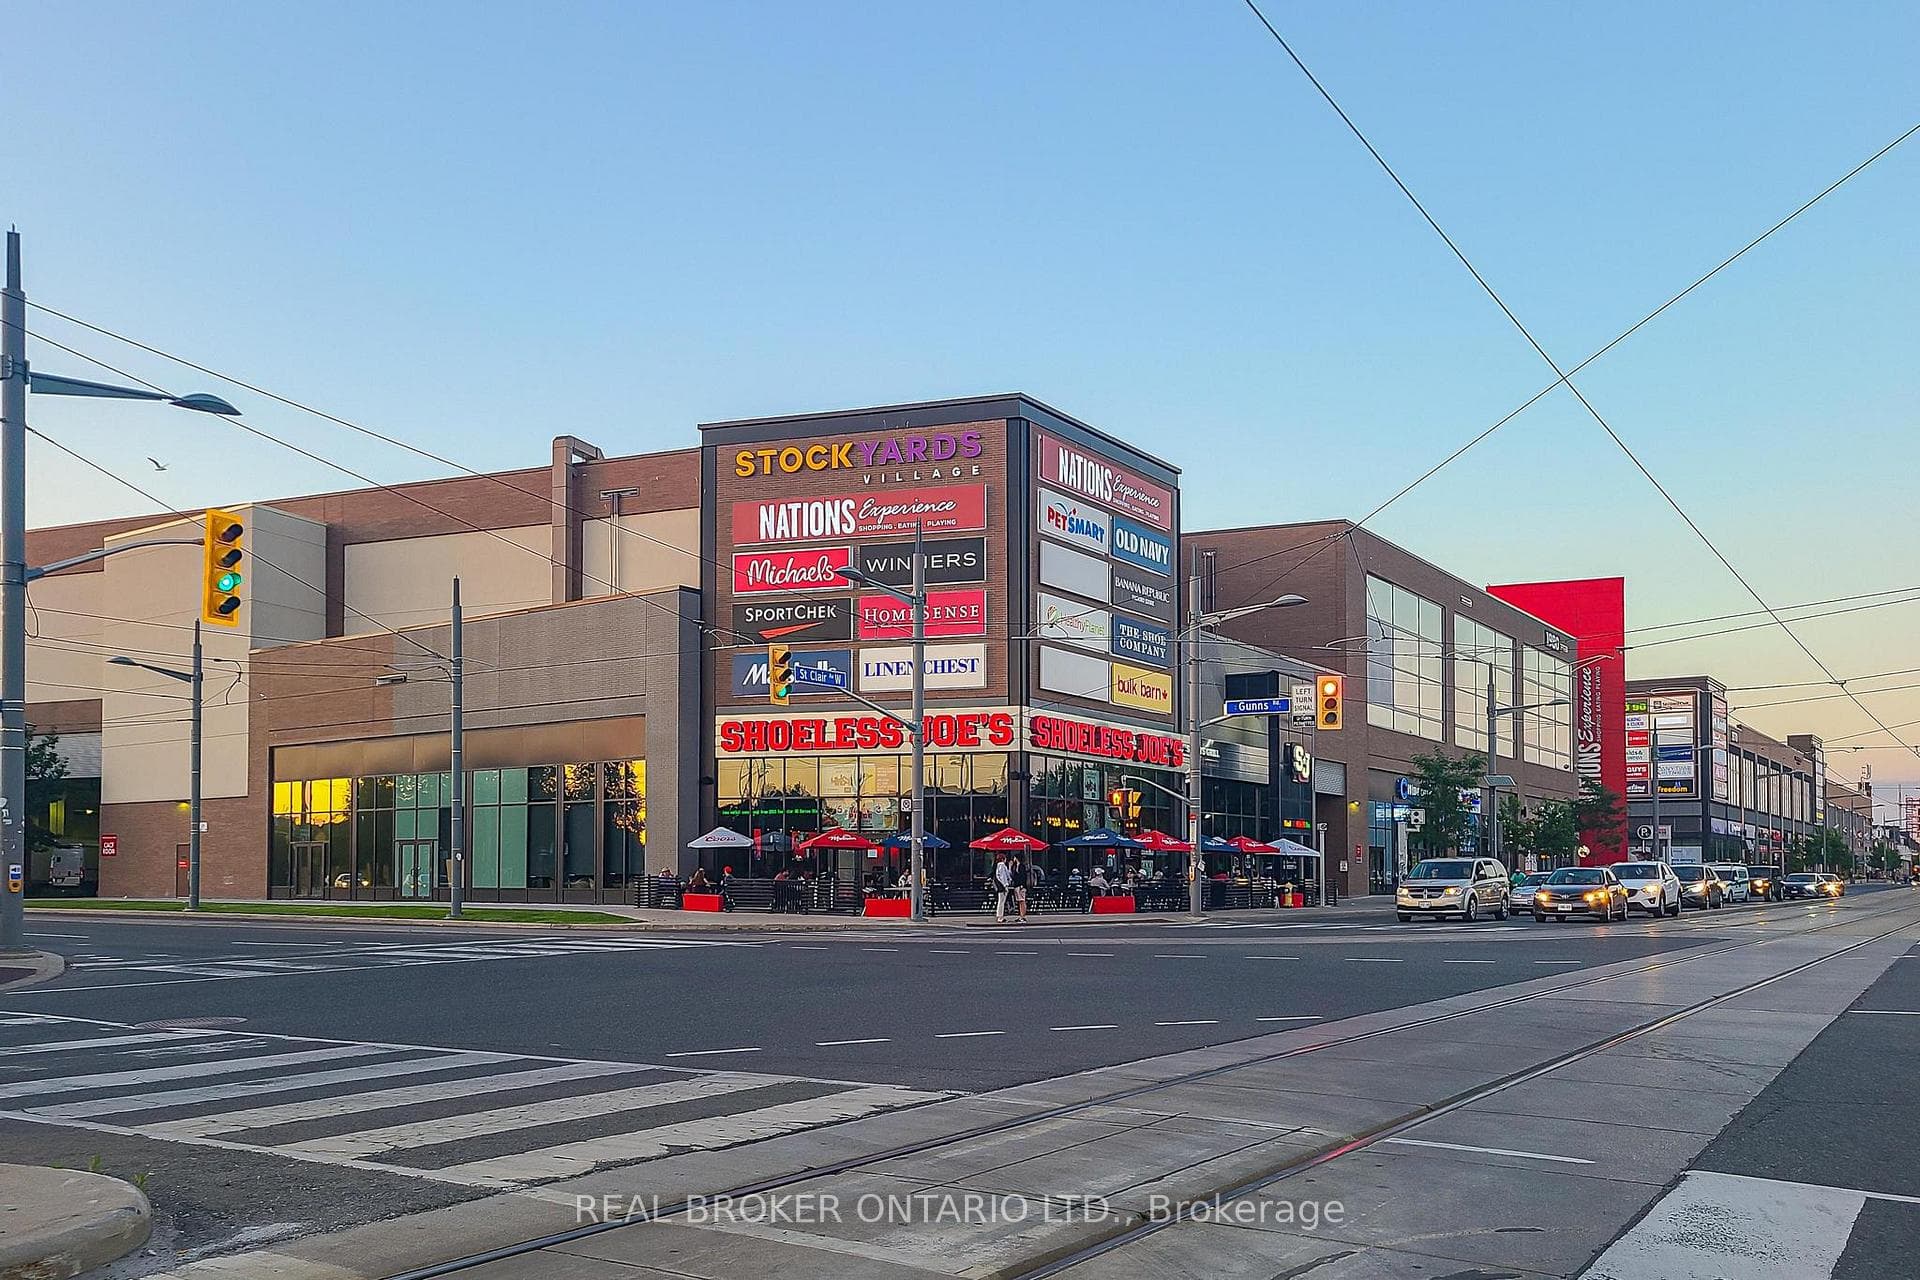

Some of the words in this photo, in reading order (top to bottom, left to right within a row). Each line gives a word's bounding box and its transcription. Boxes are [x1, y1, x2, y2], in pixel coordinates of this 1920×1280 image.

[863, 465, 981, 484] VILLAGE
[1059, 446, 1113, 502] NATIONS
[1113, 474, 1160, 508] Experience
[759, 499, 857, 540] NATIONS
[859, 498, 956, 525] Experience
[858, 523, 893, 532] SHOPPING
[926, 518, 956, 527] PLAYING
[1116, 528, 1139, 554] OLD
[1140, 538, 1170, 565] NAVY
[1115, 576, 1142, 595] BANANA
[1142, 585, 1170, 603] REPUBLIC
[1119, 624, 1140, 639] THE
[1142, 630, 1167, 647] SHOE
[1120, 637, 1167, 659] COMPANY
[800, 668, 808, 680] St
[810, 670, 827, 683] Clair
[834, 673, 842, 685] W
[923, 657, 980, 674] CHEST
[1117, 674, 1138, 695] bulk
[1140, 680, 1161, 700] barn
[1295, 687, 1311, 695] LEFT
[1238, 701, 1269, 712] Gunns
[1295, 696, 1313, 704] TURN
[1577, 666, 1596, 742] Experience
[719, 716, 905, 753] SHOELESS
[909, 712, 1016, 748] JOE'S
[1033, 714, 1134, 760] SHOELESS
[1137, 733, 1184, 768] JOE'S
